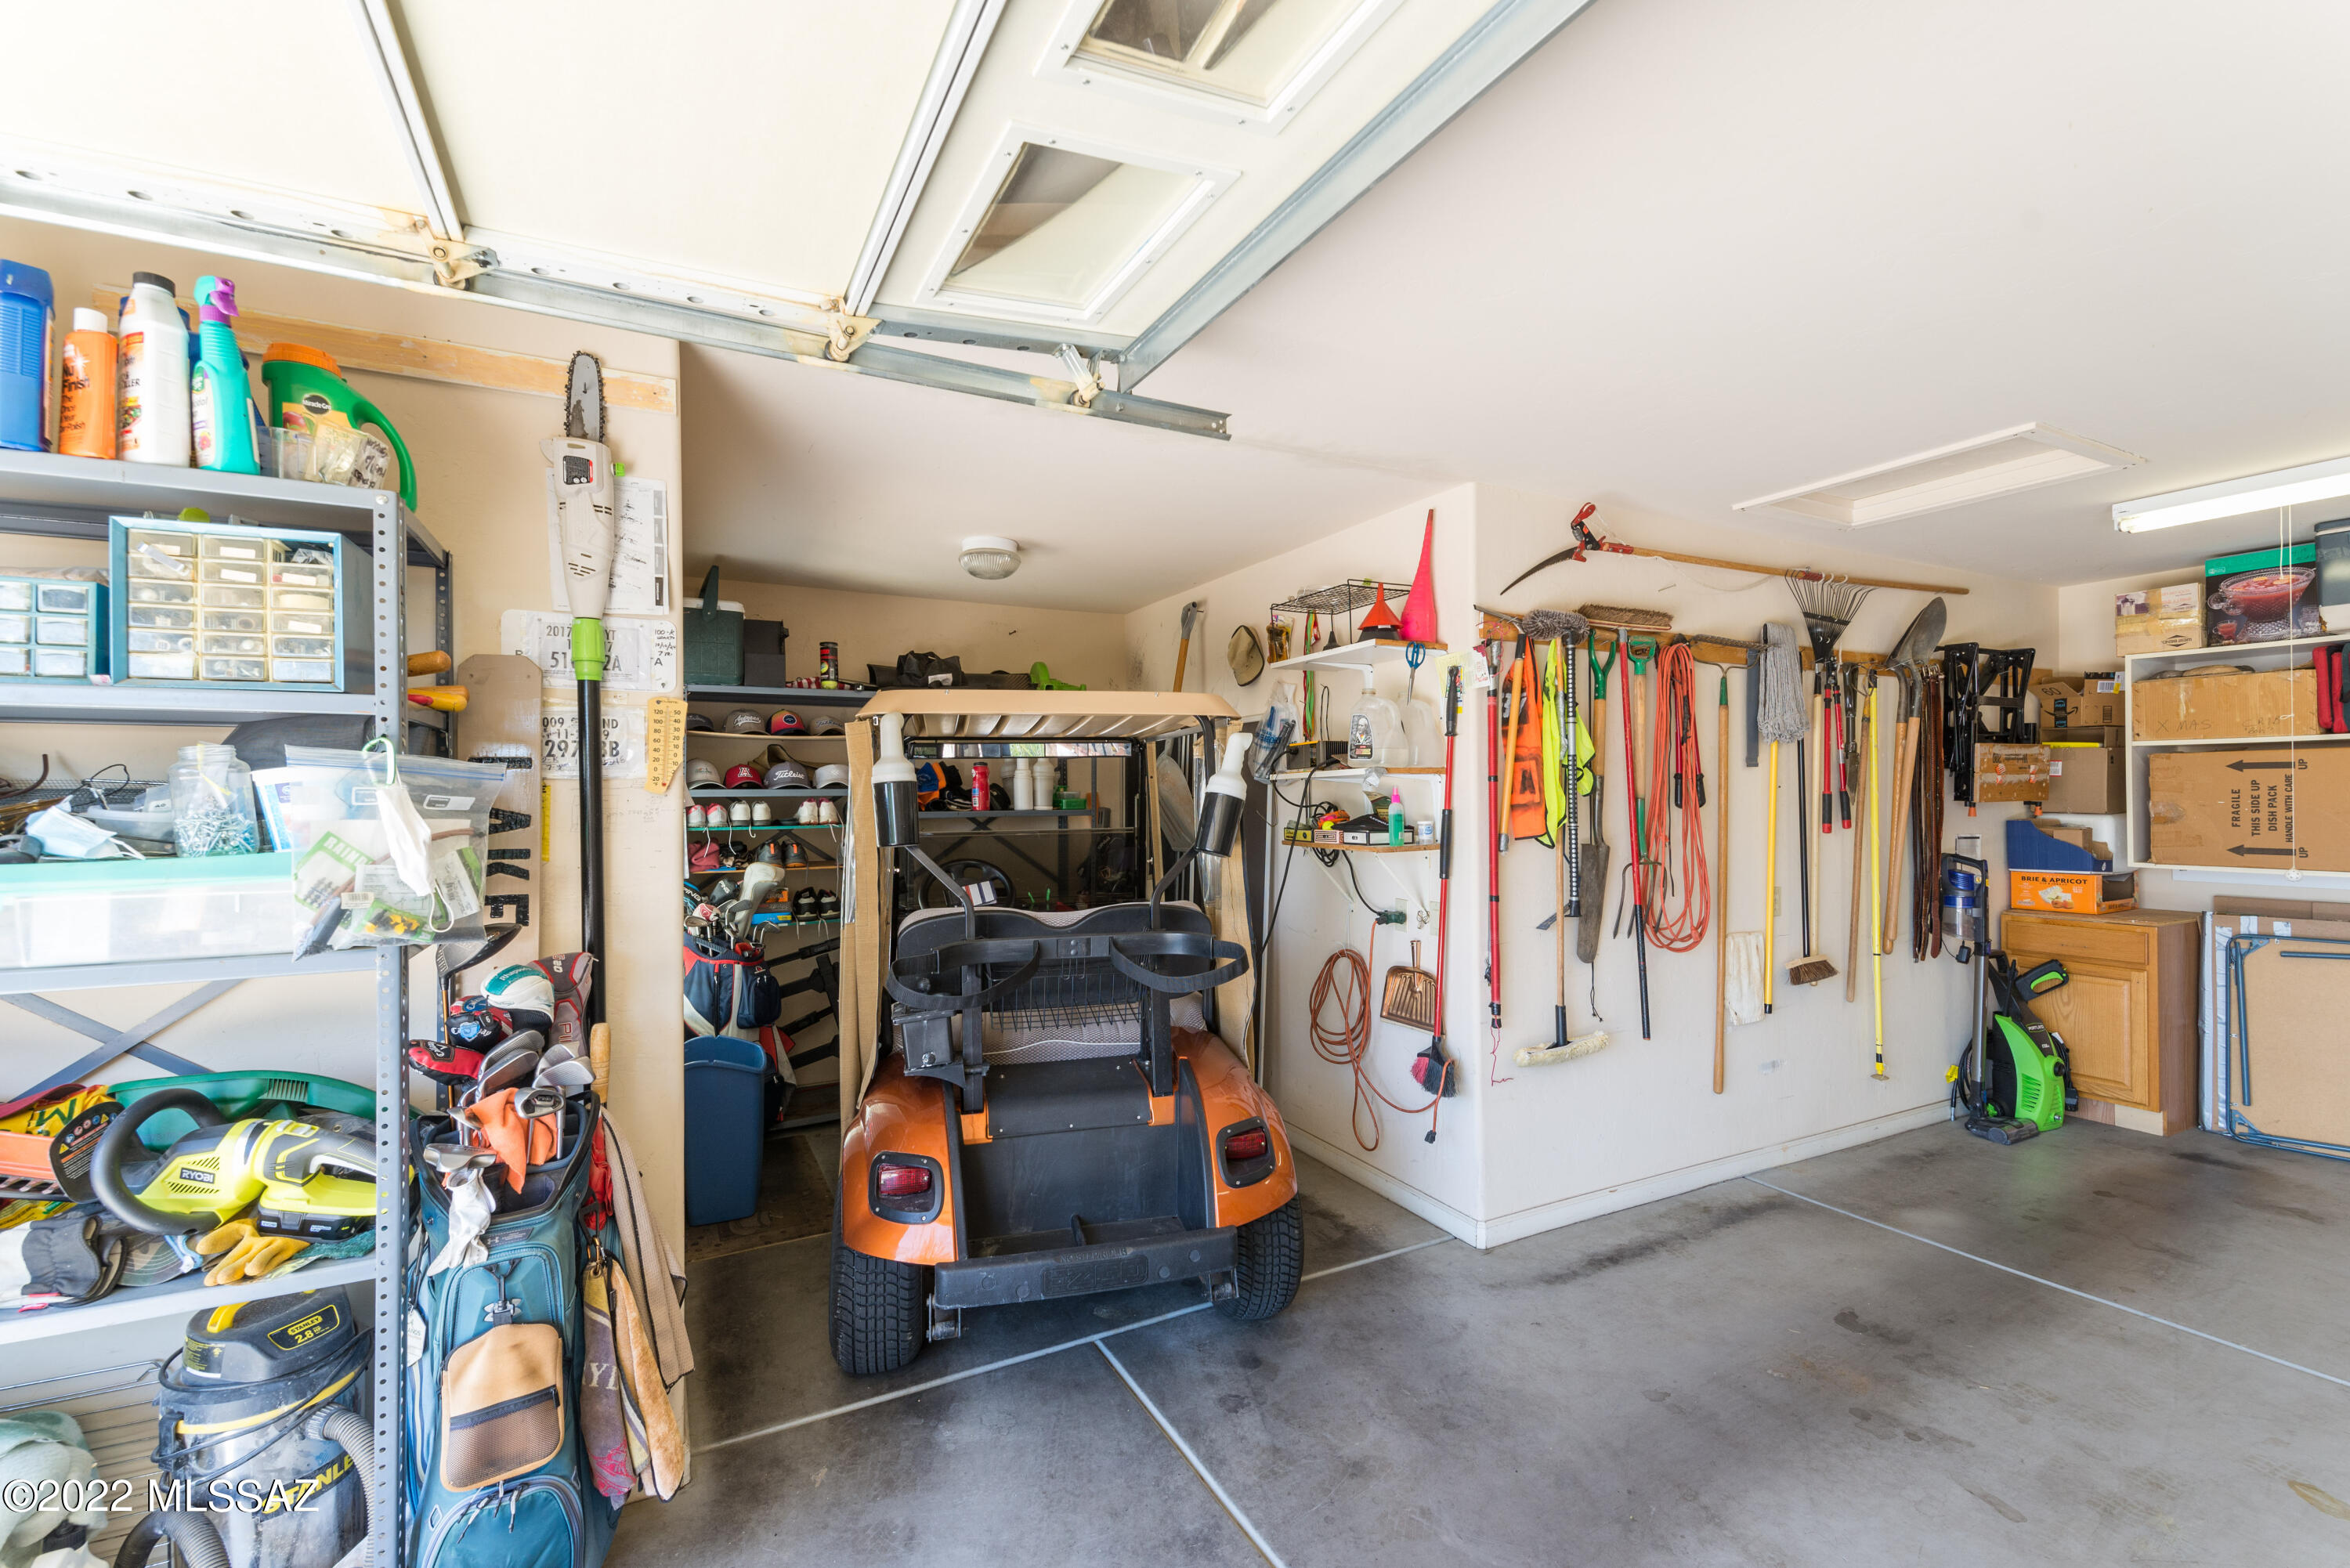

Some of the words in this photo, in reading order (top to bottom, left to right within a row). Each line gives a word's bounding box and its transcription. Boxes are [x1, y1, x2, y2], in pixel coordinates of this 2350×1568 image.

[546, 626, 572, 638] 2017
[2157, 719, 2169, 733] X
[2298, 758, 2308, 770] UP
[773, 769, 805, 781] Titleist
[2251, 779, 2261, 791] UP
[2251, 794, 2261, 814] SIDE
[2268, 785, 2277, 808] PACK
[2285, 795, 2294, 813] WITH
[2231, 789, 2241, 828] FRAGILE
[2251, 817, 2261, 836] THIS
[2268, 811, 2277, 831] DISH
[2285, 815, 2294, 843] HANDLE
[2298, 847, 2308, 858] UP
[718, 880, 731, 894] PING
[181, 1169, 215, 1183] RYOBI
[290, 1317, 320, 1334] STANLEY
[295, 1330, 313, 1344] 2.8
[262, 1453, 355, 1514] STANLE
